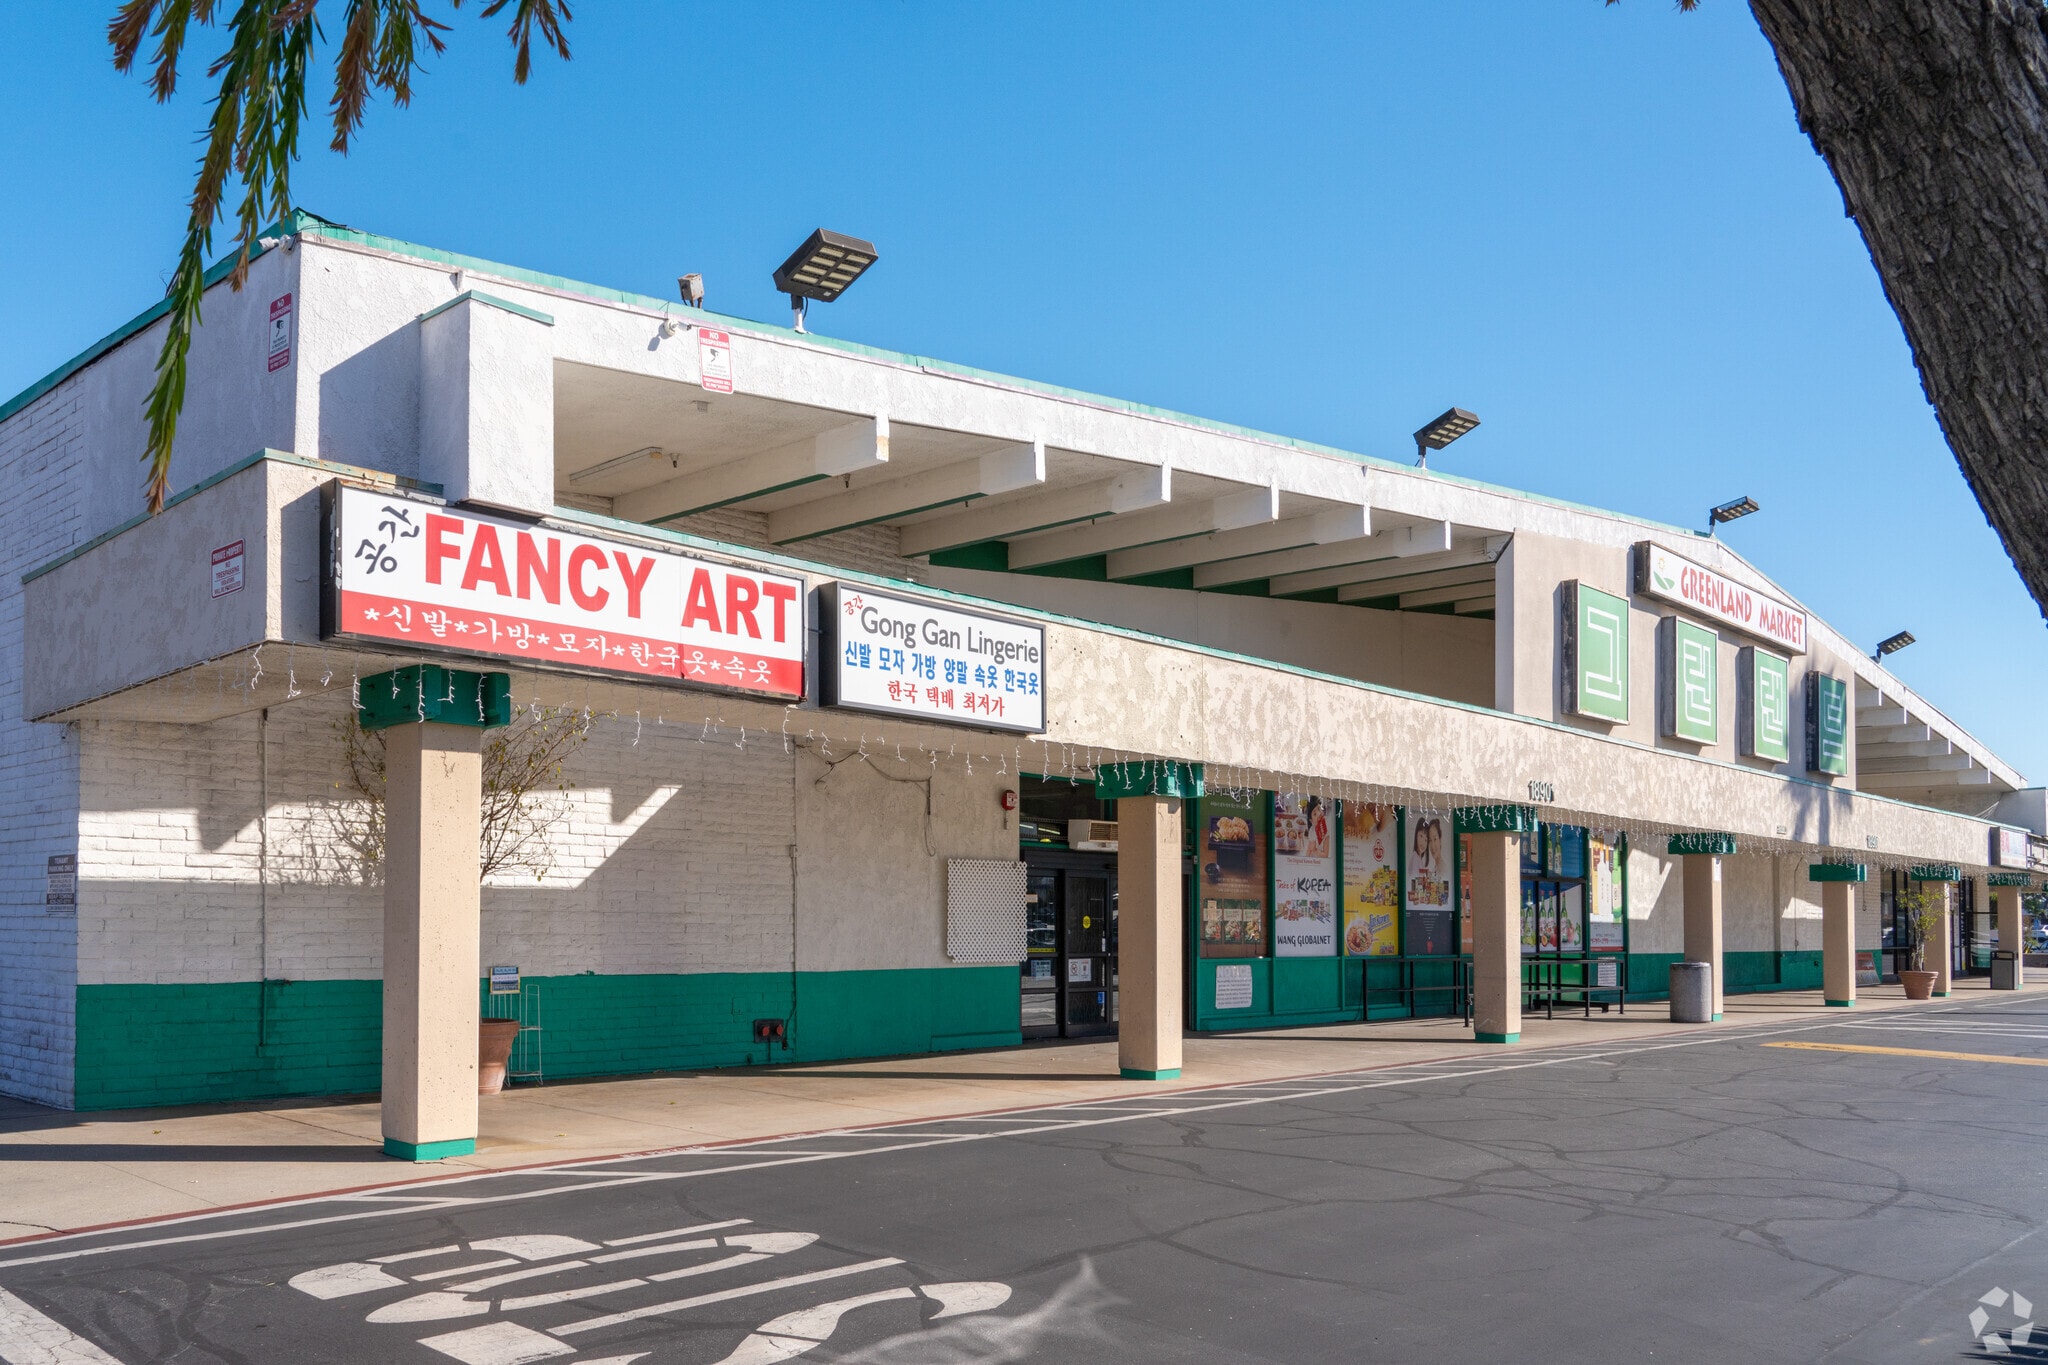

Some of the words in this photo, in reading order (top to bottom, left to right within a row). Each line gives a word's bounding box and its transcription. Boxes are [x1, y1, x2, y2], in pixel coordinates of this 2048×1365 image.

[709, 331, 719, 340] NO
[425, 512, 656, 620] FANCY
[681, 567, 797, 643] ART
[1680, 566, 1753, 622] GREENLAND
[1759, 601, 1803, 645] MARKET
[471, 617, 536, 650] 가방
[553, 633, 612, 661] 모자
[723, 655, 772, 684] 속옷
[861, 606, 917, 649] Gong
[922, 618, 961, 650] Gan
[967, 626, 1039, 665] Lingerie
[845, 640, 872, 669] 신발
[879, 647, 905, 674] 모자
[911, 653, 937, 680] 가방
[943, 658, 968, 685] 양말
[974, 664, 999, 690] 속옷
[1004, 668, 1039, 696] 한국옷
[887, 680, 918, 704] 한국
[926, 687, 955, 711] 택배
[963, 692, 1005, 717] 최저가
[1297, 877, 1331, 896] KOREA
[1277, 935, 1296, 947] WANG
[1298, 935, 1331, 947] GLOBALNET
[1217, 965, 1251, 978] NOTICE
